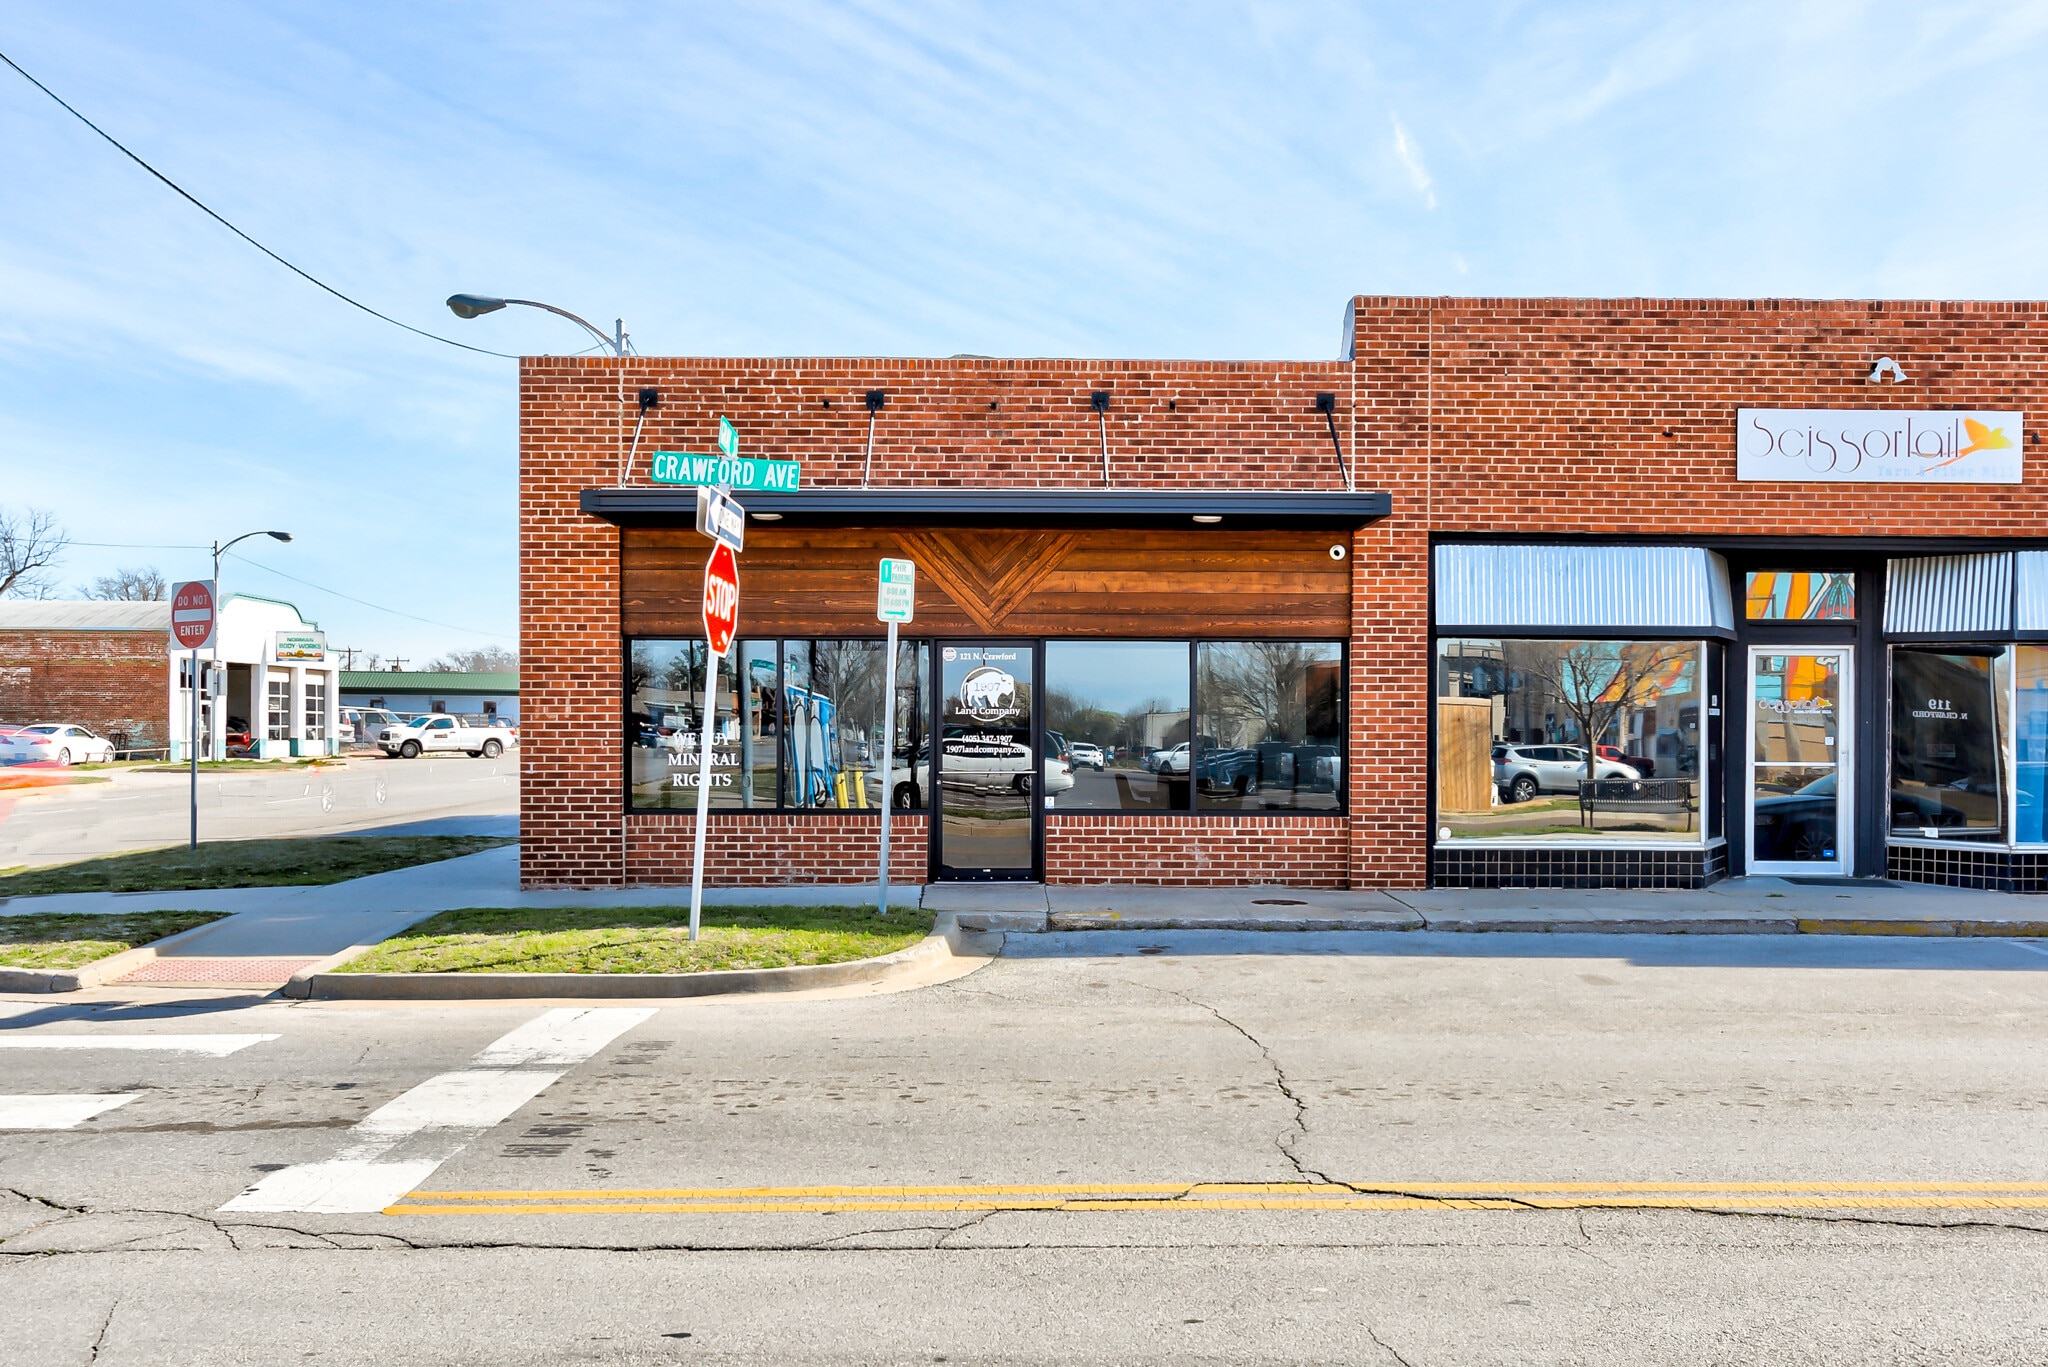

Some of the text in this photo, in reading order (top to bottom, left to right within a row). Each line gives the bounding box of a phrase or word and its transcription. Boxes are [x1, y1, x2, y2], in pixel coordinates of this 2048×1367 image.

[654, 454, 799, 489] CRAWFORD AVE
[178, 594, 208, 607] DO NOT
[707, 574, 736, 622] STOP
[180, 624, 205, 636] ENTER
[982, 652, 1017, 660] Crawford
[974, 682, 1001, 692] 1907
[955, 707, 1021, 717] Land Company
[700, 732, 729, 746] UY
[961, 734, 1013, 744] (405) 347-1907
[667, 753, 740, 766] MINRAL
